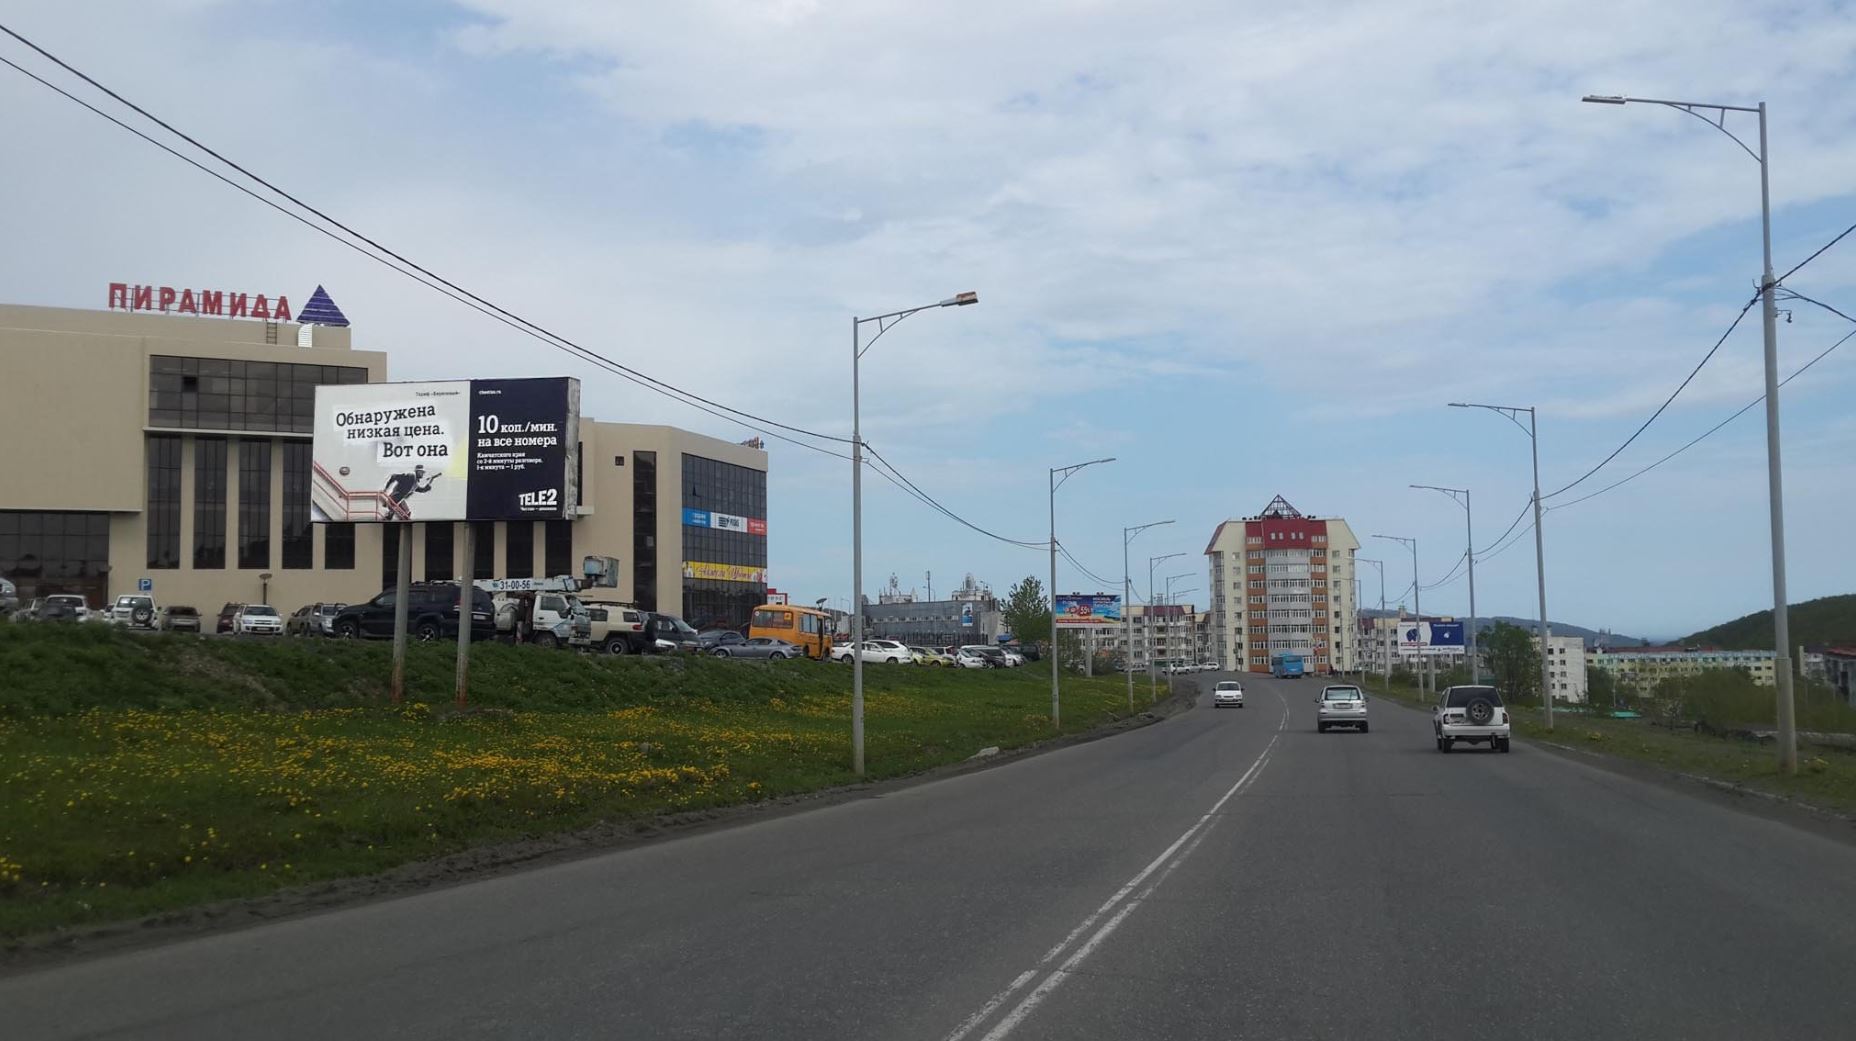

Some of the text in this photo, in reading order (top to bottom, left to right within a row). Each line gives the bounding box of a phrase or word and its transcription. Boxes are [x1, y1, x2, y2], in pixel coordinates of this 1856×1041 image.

[108, 282, 292, 321] ПИРАМИДА
[335, 405, 436, 427] Обнаружена
[477, 414, 558, 434] 10 коп./мин.
[346, 424, 445, 439] низкая цена.
[383, 441, 448, 458] Вот она
[477, 436, 558, 448] на все номера
[518, 488, 558, 506] TELE2
[141, 579, 151, 590] P
[499, 579, 531, 590] 31-00-56
